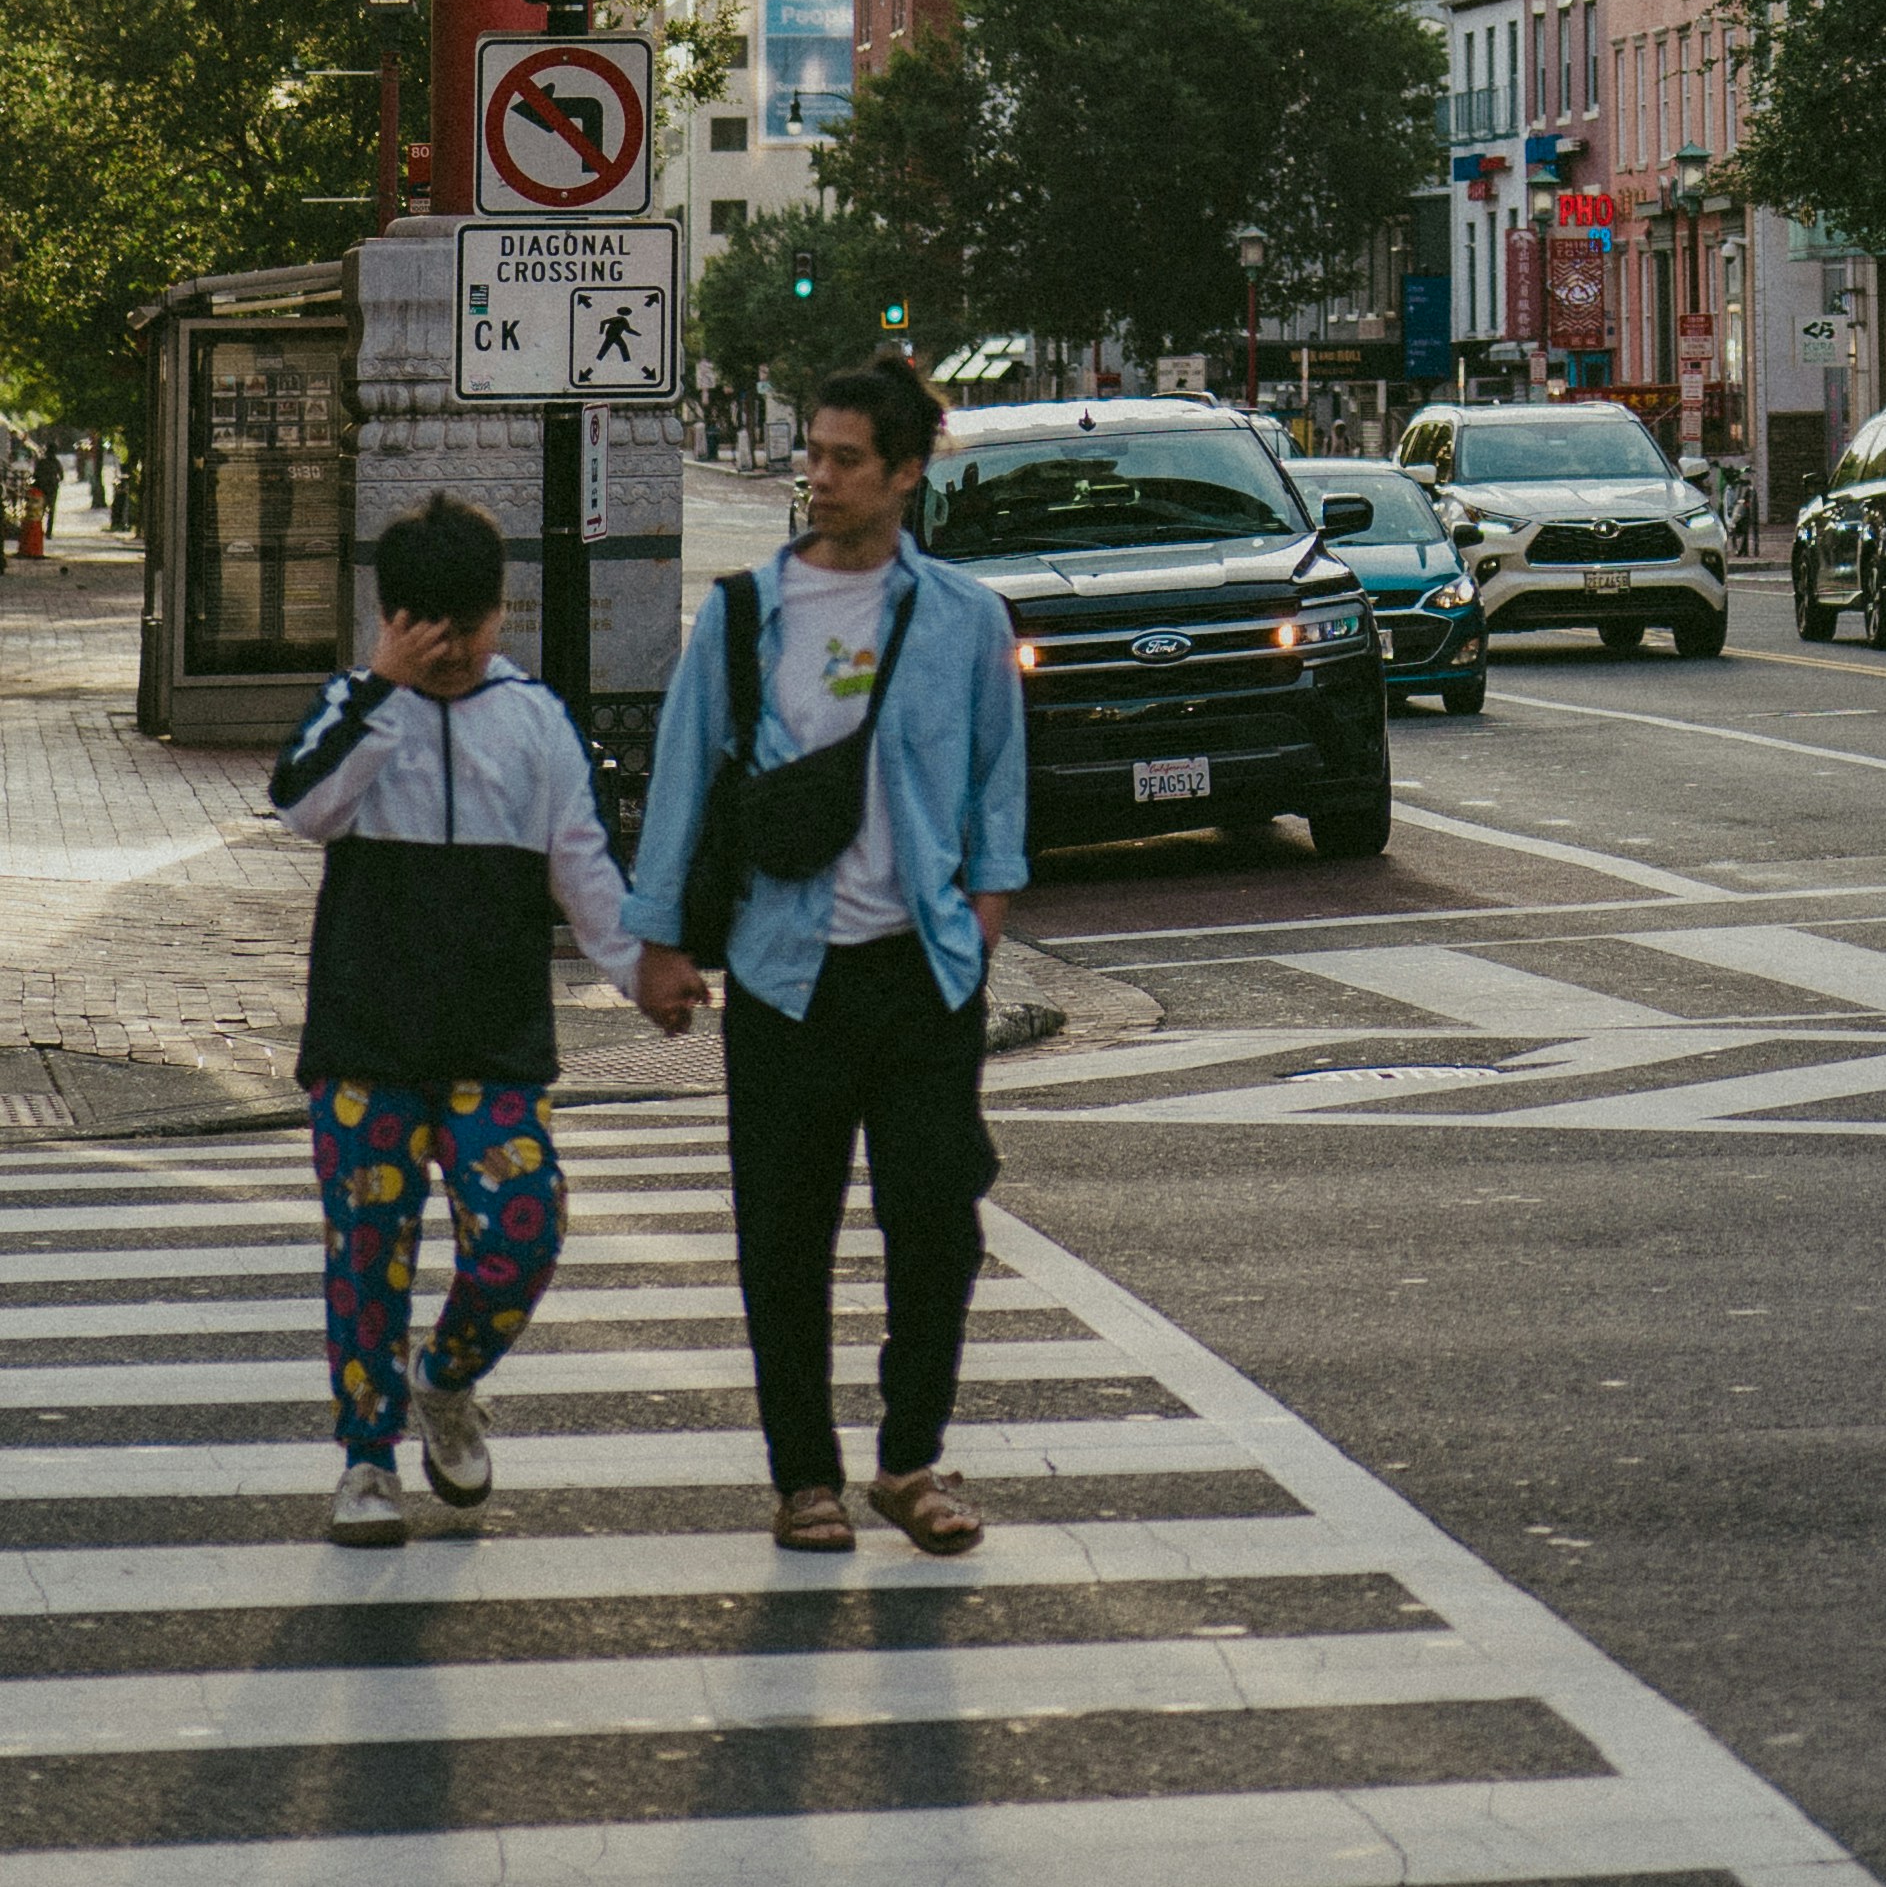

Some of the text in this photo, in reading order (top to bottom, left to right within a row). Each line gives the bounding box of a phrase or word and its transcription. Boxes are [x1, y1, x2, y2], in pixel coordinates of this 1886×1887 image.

[1559, 194, 1613, 226] PHO
[501, 235, 631, 256] DIAGONAL
[497, 261, 623, 282] CROSSING
[1803, 322, 1835, 339] くら
[1146, 639, 1176, 654] Ford
[1150, 764, 1192, 774] California
[1139, 773, 1205, 796] 9EAG512
